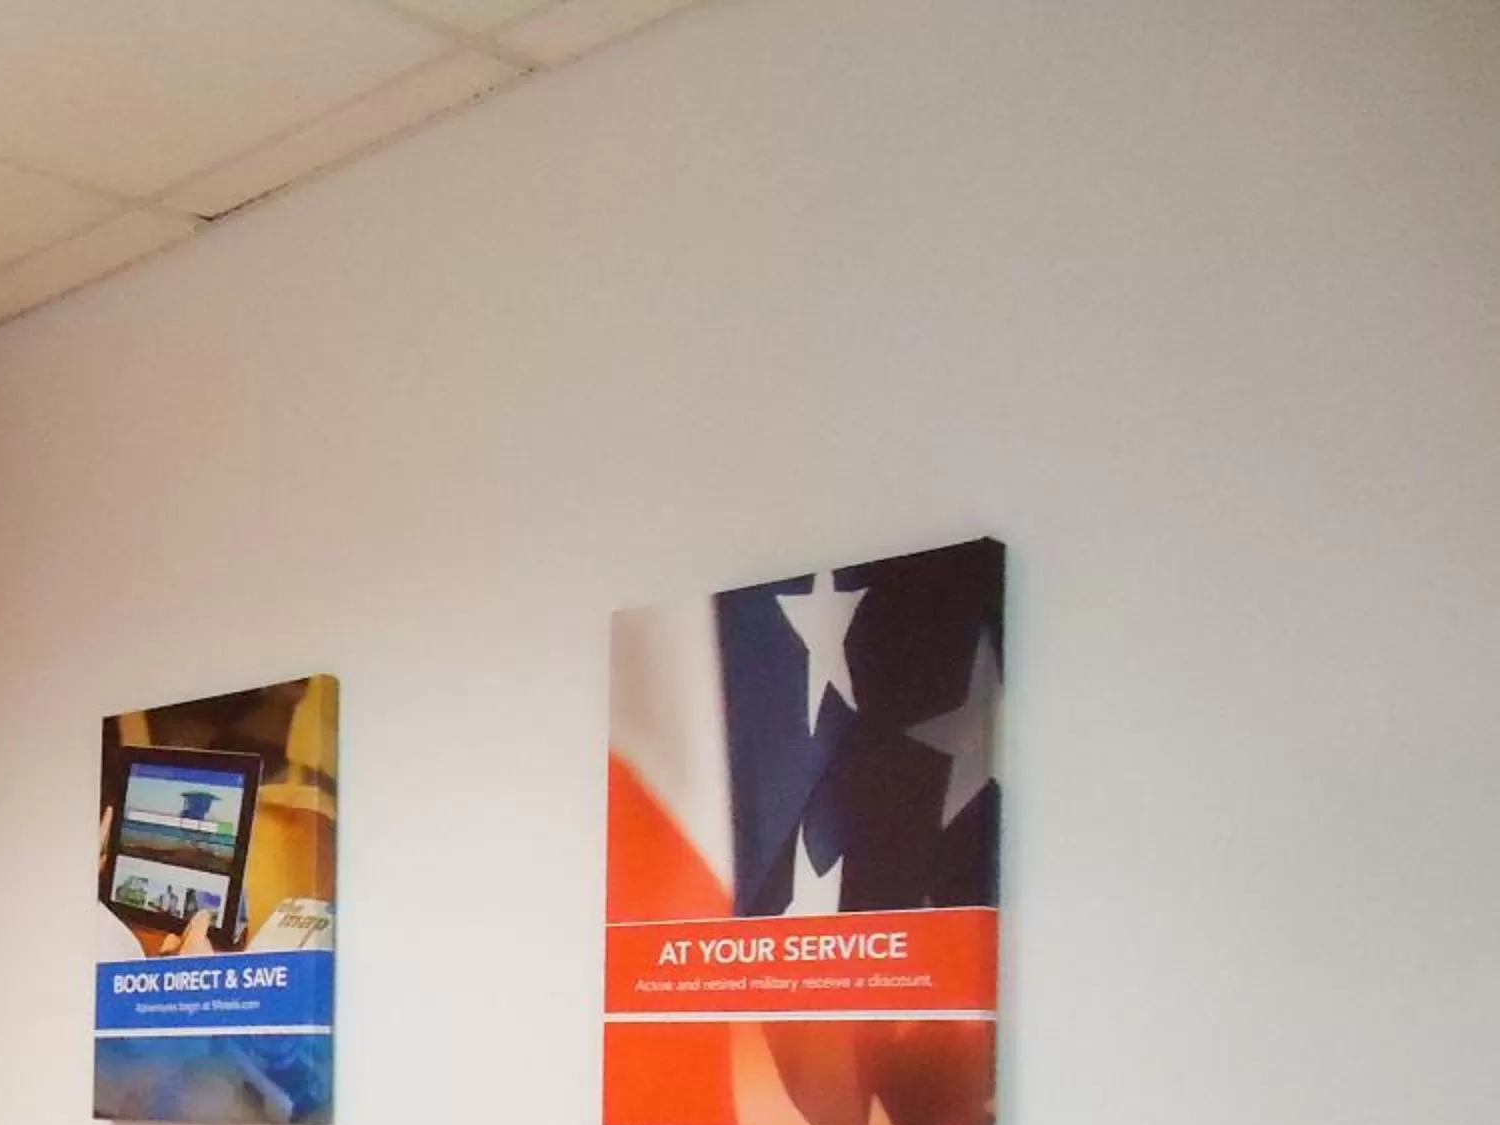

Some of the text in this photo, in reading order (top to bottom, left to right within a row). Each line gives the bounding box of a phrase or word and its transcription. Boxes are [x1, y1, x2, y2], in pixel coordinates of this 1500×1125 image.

[658, 932, 909, 966] AT YOUR SERVICE
[113, 966, 288, 994] BOOK DIRECT & SAVE
[634, 978, 673, 992] Active
[676, 976, 701, 992] and
[703, 976, 747, 991] retired
[749, 975, 798, 993] military
[854, 977, 865, 988] a
